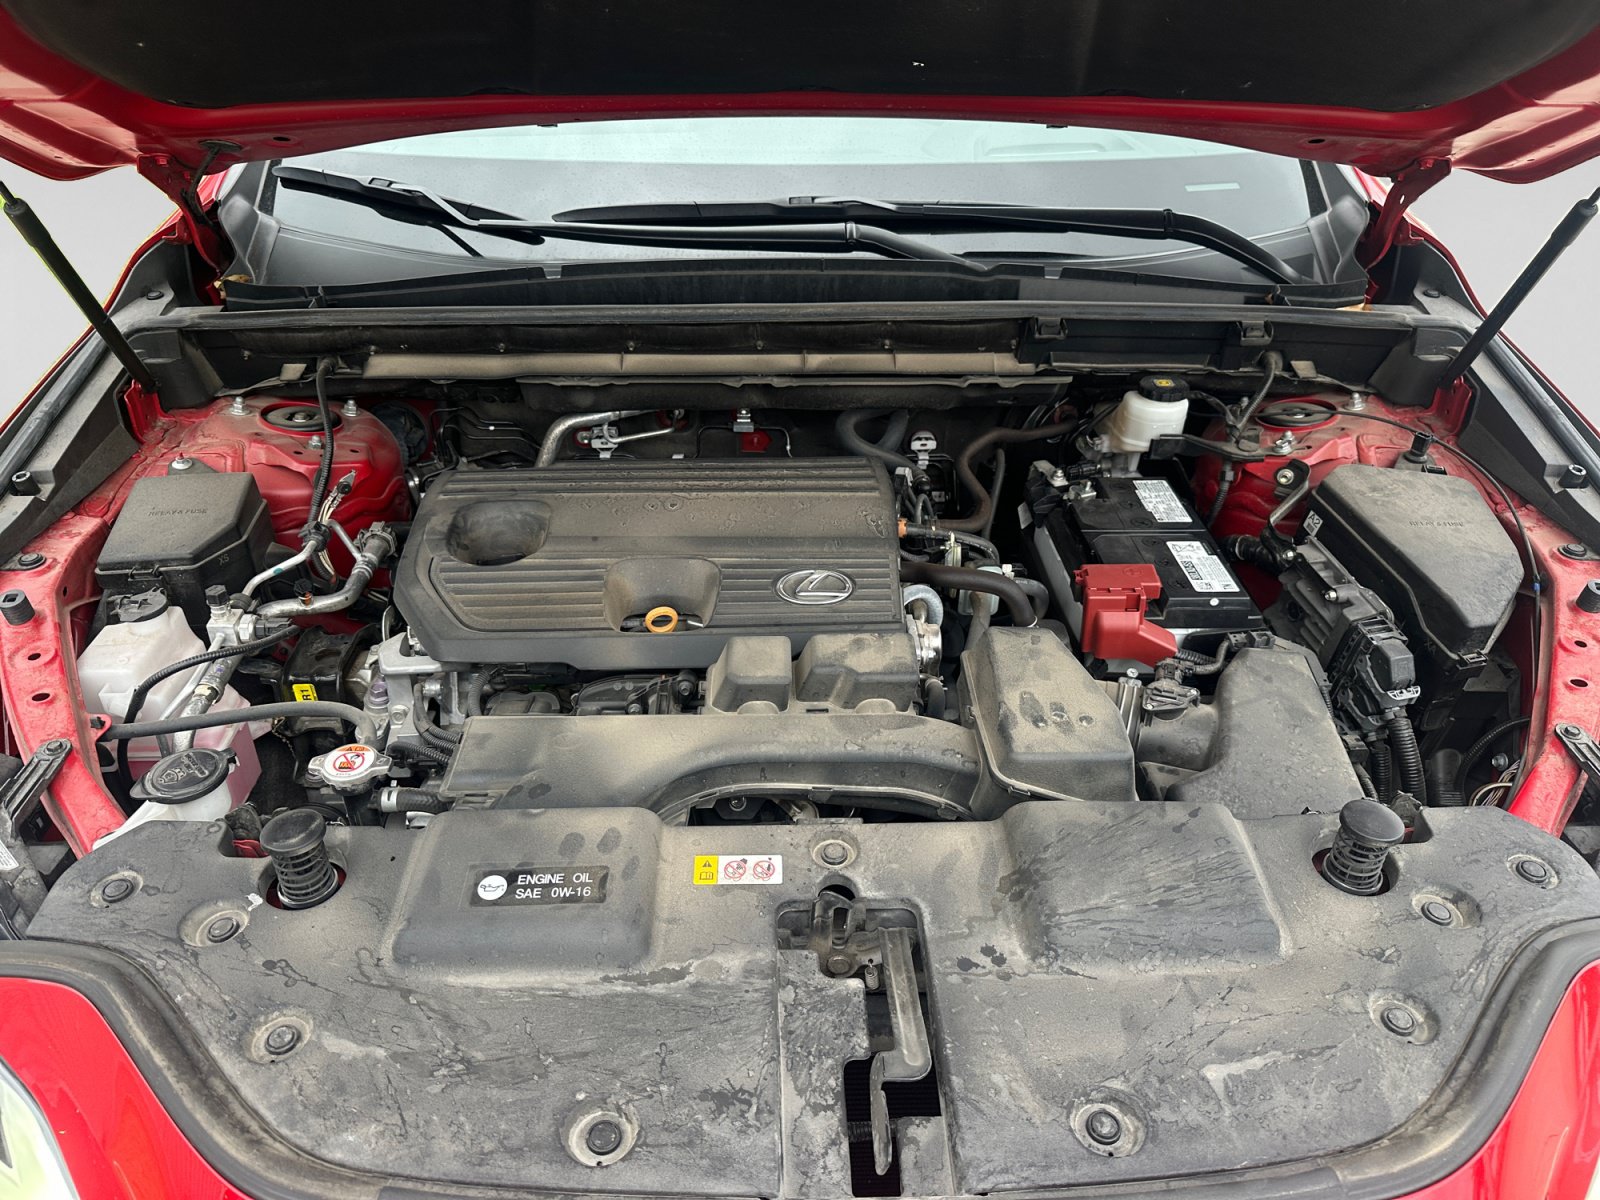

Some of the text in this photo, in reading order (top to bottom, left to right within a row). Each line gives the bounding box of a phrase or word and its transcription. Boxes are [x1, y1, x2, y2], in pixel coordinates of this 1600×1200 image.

[1308, 513, 1321, 529] A2
[517, 872, 593, 885] ENGINE OIL
[515, 886, 592, 899] SAE 0W-16
